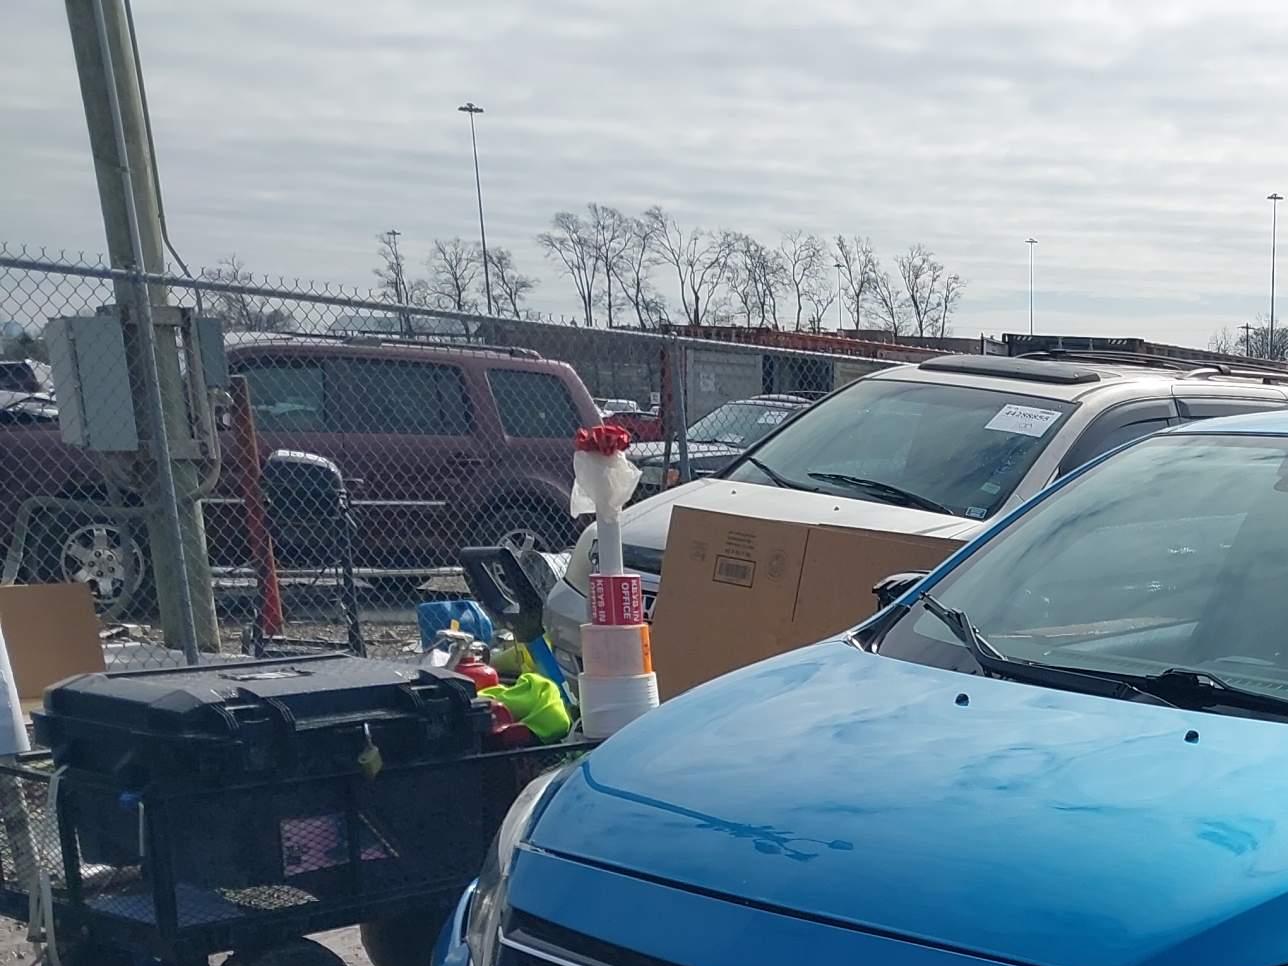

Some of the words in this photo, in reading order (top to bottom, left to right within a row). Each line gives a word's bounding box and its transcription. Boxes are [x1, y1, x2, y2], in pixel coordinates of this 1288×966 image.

[622, 583, 631, 619] OFFICE
[631, 579, 640, 608] KEYS
[633, 611, 640, 621] IN
